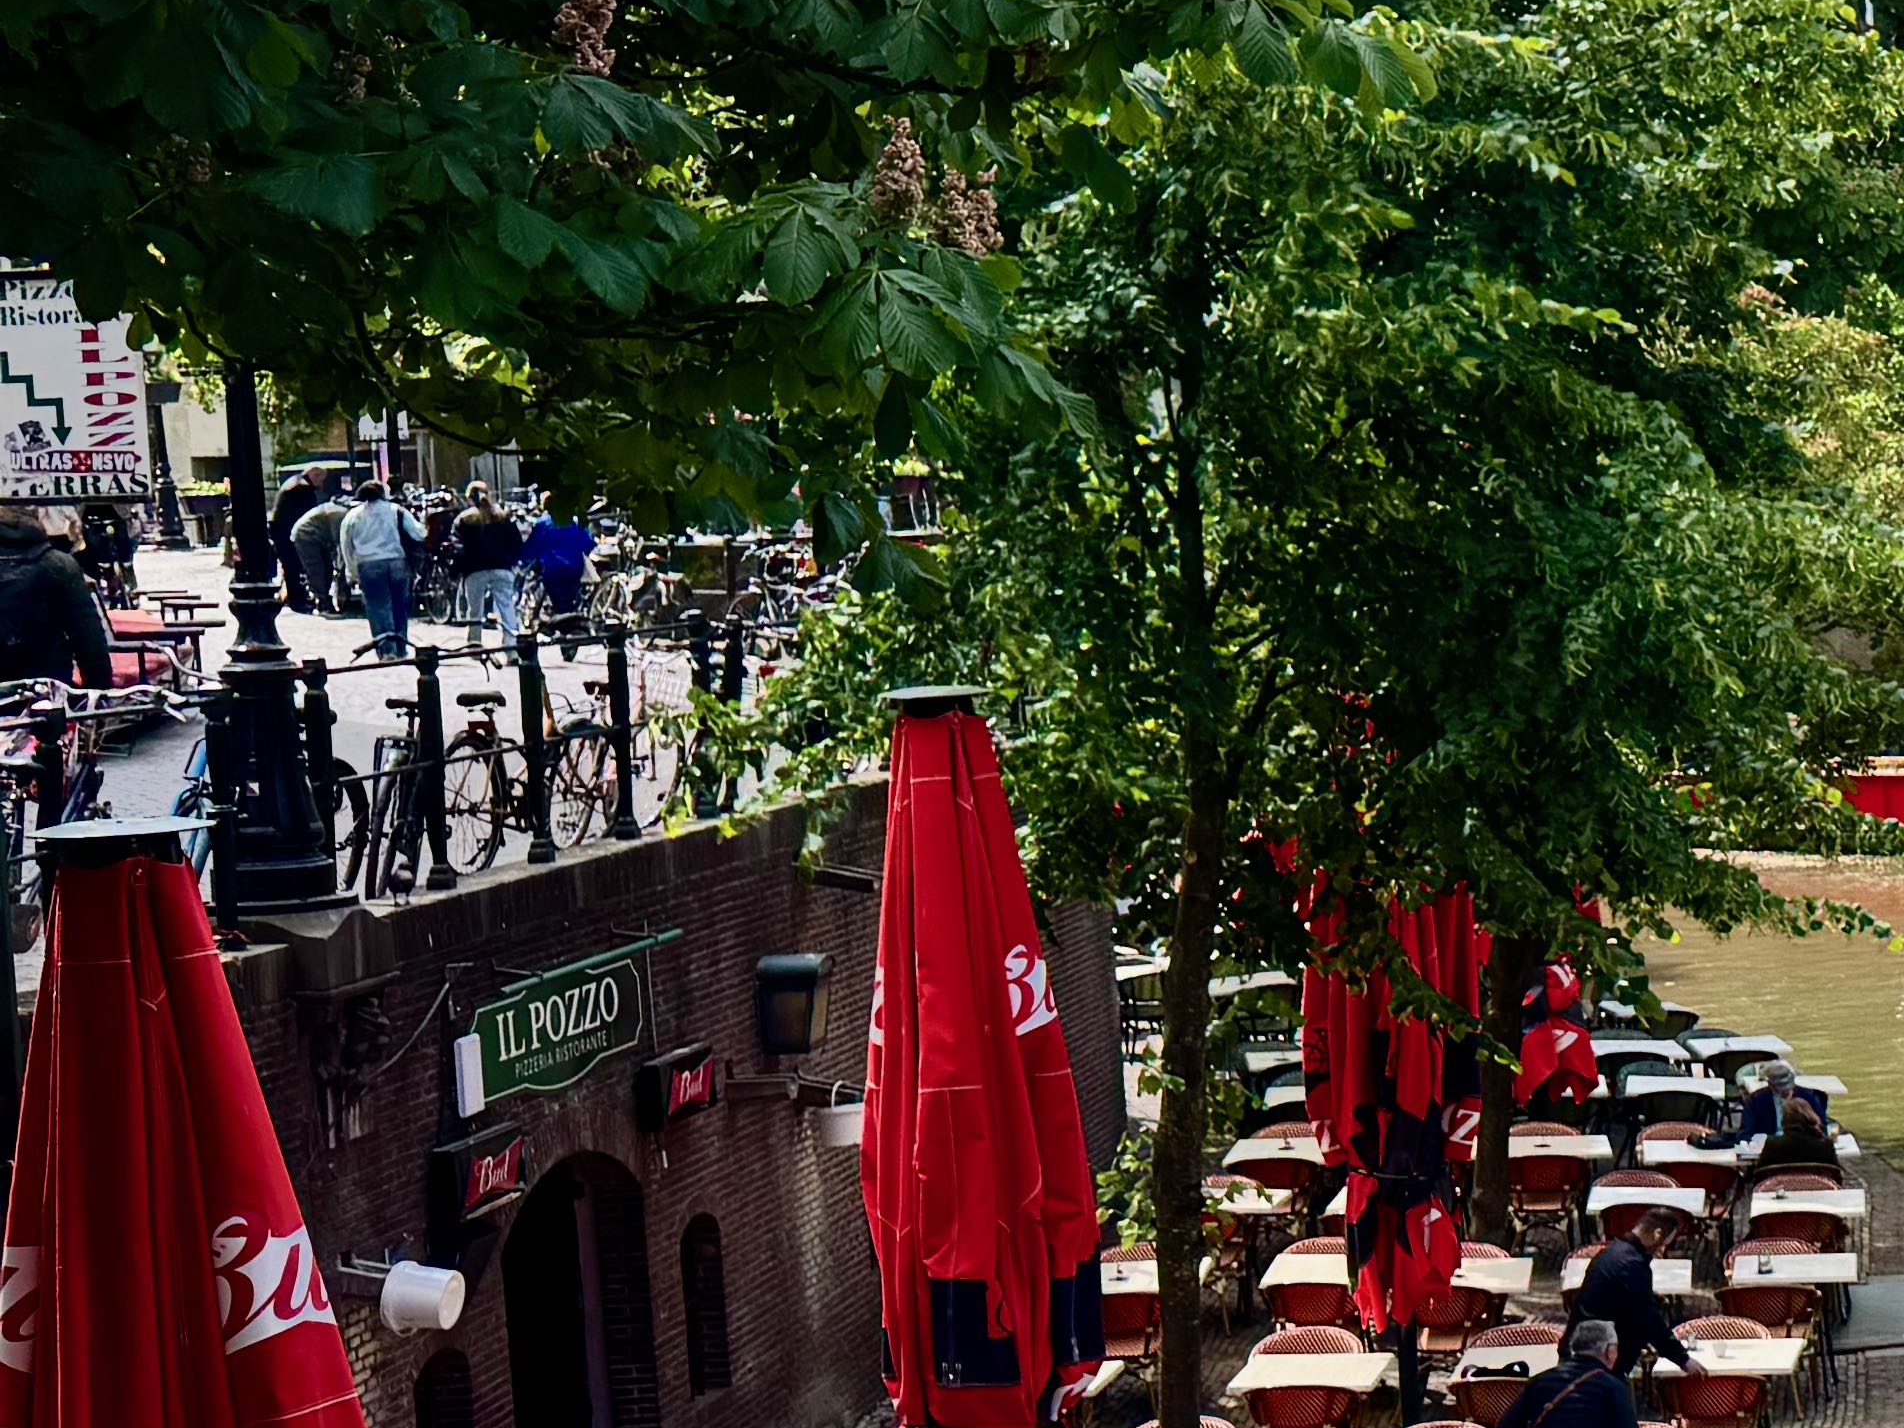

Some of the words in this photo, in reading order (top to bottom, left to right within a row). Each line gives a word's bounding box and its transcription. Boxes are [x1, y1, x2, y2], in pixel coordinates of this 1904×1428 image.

[495, 1009, 526, 1062] IL
[528, 976, 619, 1051] POZZO
[515, 1051, 553, 1079] PIZZERIA
[555, 1029, 608, 1065] RISTORANTE
[476, 1150, 510, 1194] Bud
